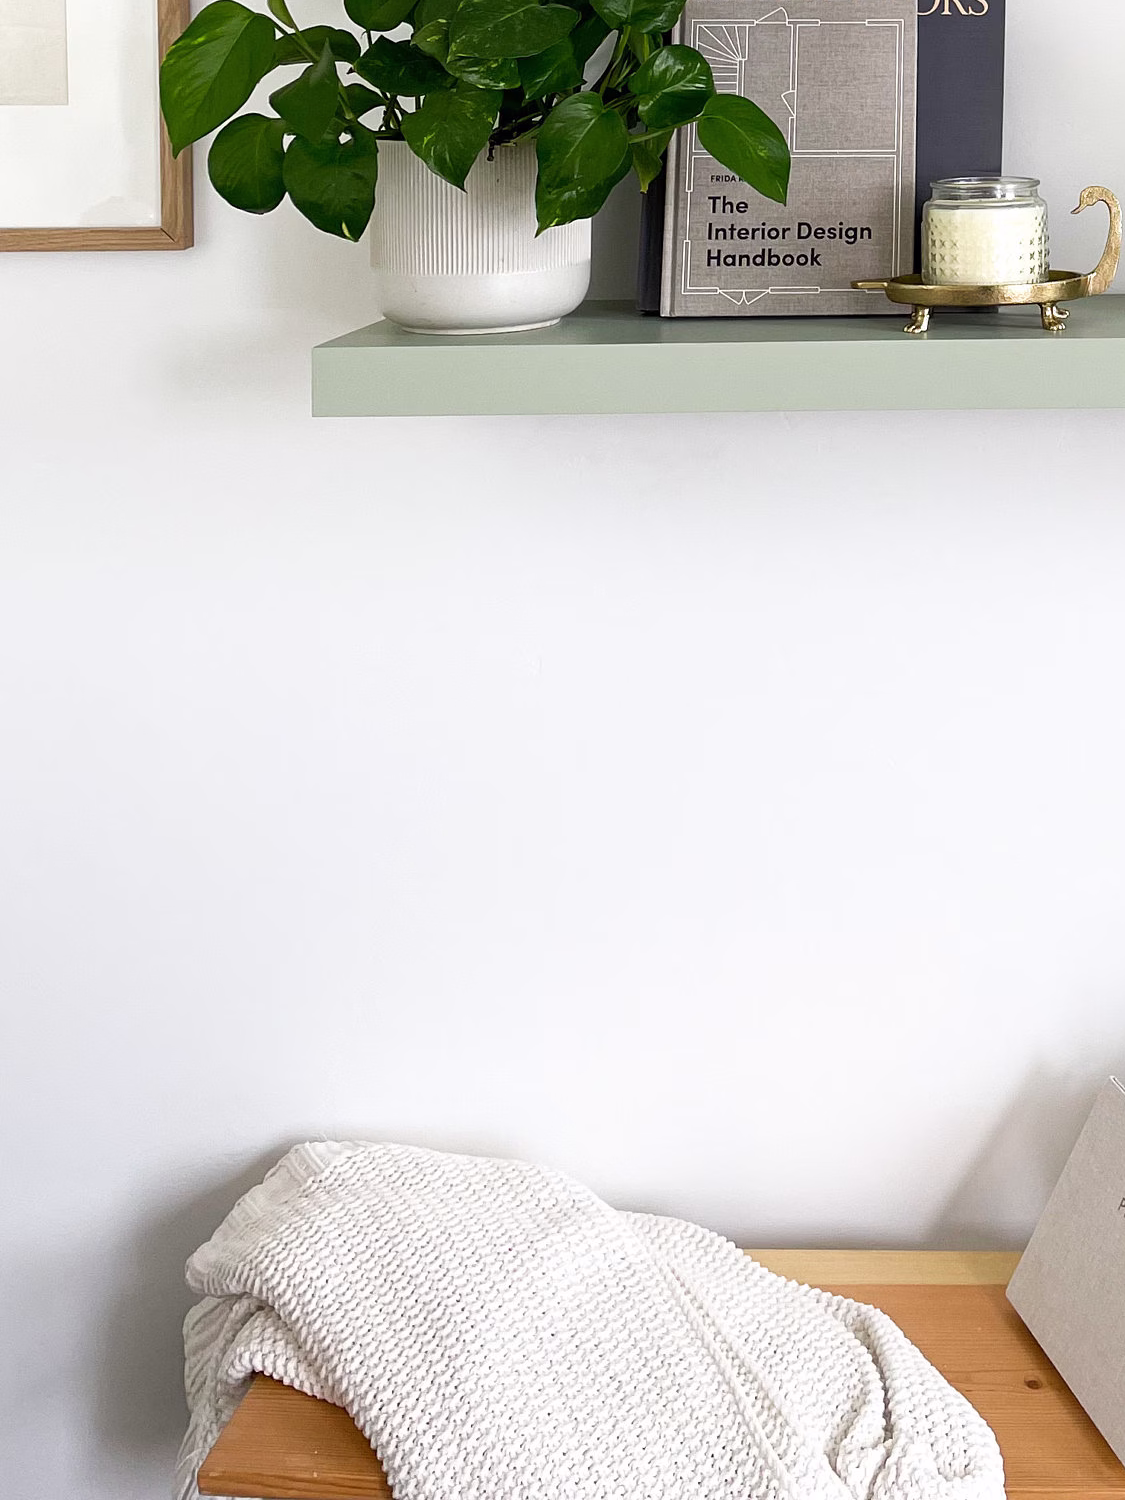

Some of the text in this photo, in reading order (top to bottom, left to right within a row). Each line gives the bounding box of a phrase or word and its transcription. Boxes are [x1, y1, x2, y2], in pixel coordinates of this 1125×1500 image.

[707, 195, 749, 214] The
[707, 222, 872, 245] Interior Design
[707, 248, 822, 267] Handbook
